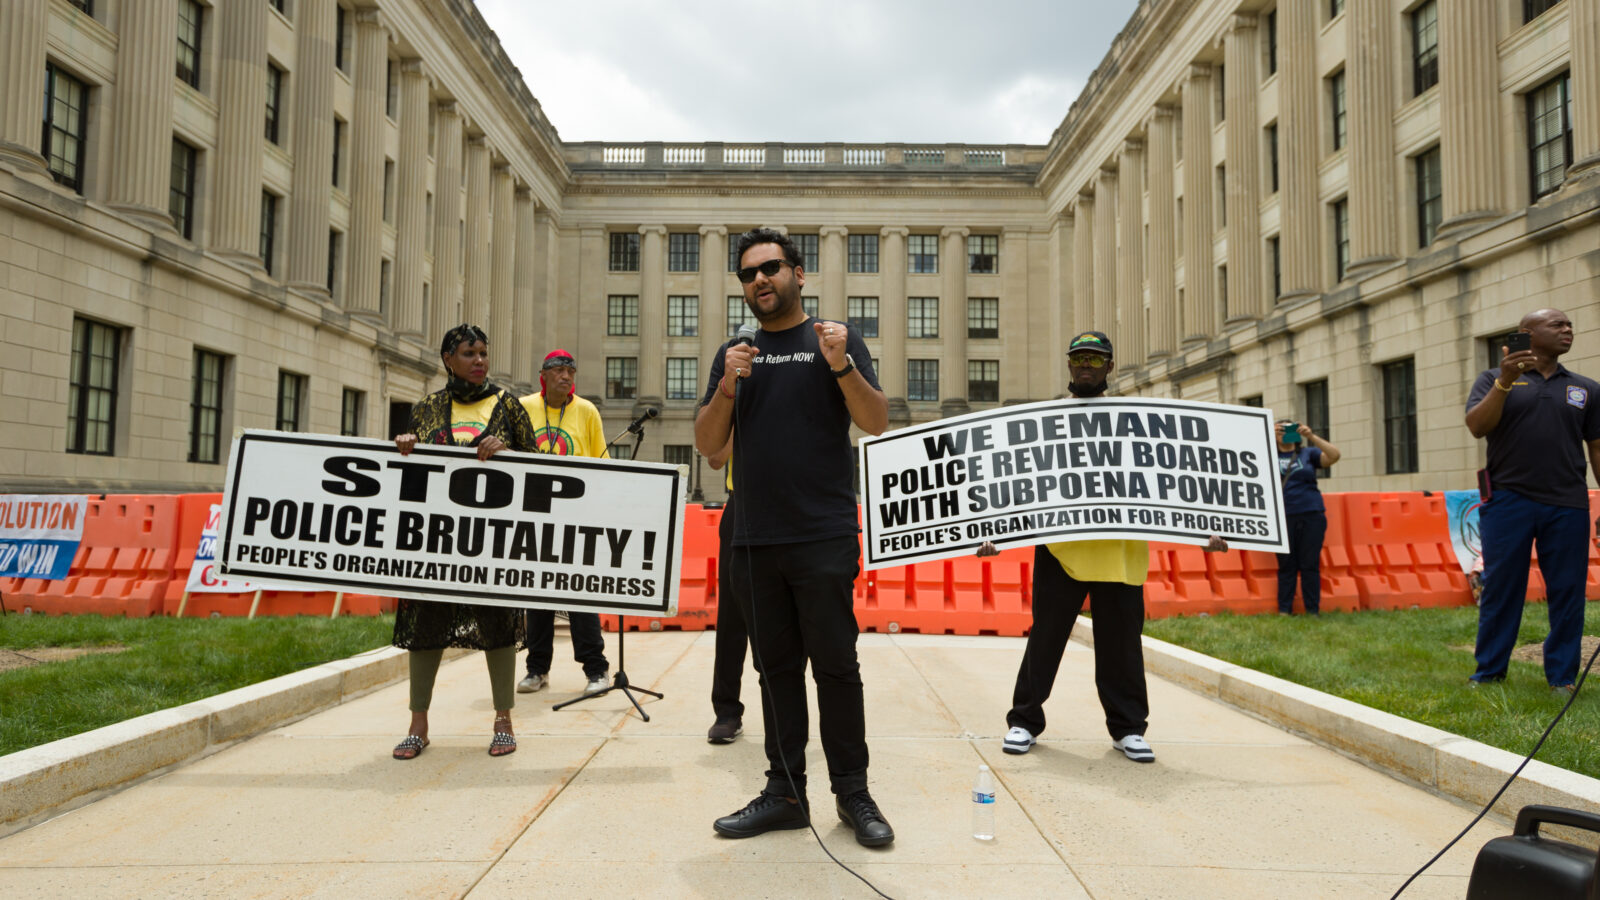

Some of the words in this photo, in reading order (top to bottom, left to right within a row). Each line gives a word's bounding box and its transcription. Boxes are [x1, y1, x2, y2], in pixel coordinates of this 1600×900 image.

[766, 354, 791, 364] Reform
[792, 352, 815, 363] NOW!
[923, 425, 995, 461] WE
[1006, 412, 1210, 446] DEMAND
[321, 455, 586, 515] STOP
[881, 456, 985, 500] POLICE
[992, 441, 1122, 478] REVIEW
[1132, 441, 1259, 479] BOARDS
[879, 489, 960, 529] WITH
[967, 471, 1151, 513] SUBPOENA
[1157, 472, 1266, 511] POWER
[243, 496, 387, 549] POLICE
[395, 510, 633, 569] BRUTALITY
[879, 525, 962, 554] PEOPLE'S
[966, 508, 1121, 539] ORGANIZATION
[1127, 508, 1167, 526] FOR
[1171, 511, 1270, 537] PROGRESS
[18, 543, 59, 575] WIN
[236, 543, 328, 570] PEOPLE'S
[332, 553, 489, 585] ORGANIZATION
[494, 567, 535, 589] FOR
[540, 571, 656, 598] PROGRESS
